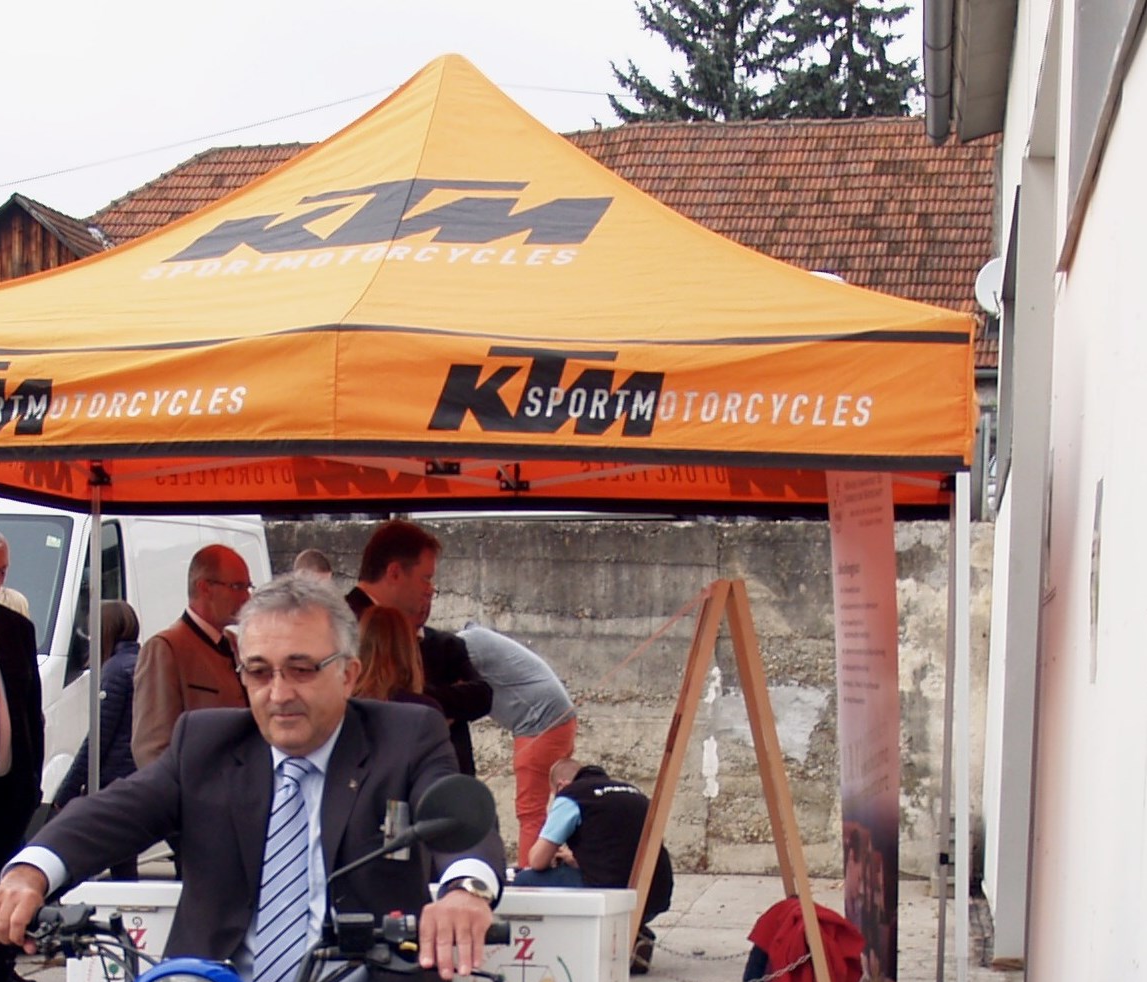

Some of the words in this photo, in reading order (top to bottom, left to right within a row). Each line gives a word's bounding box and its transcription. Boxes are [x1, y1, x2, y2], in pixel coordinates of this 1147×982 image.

[162, 178, 614, 263] KTM
[140, 245, 579, 281] SPORTMOTORCYCLES
[427, 346, 664, 437] KTM
[524, 386, 873, 427] SPORTMOTORCYCLES
